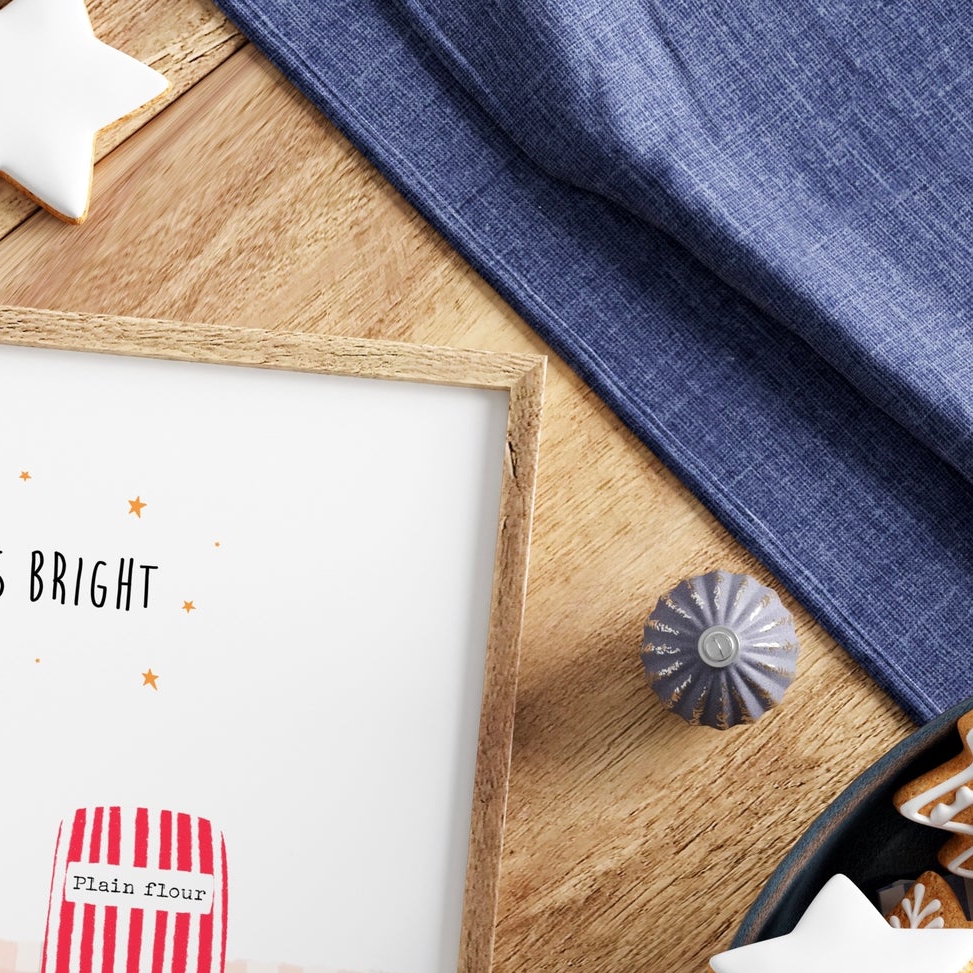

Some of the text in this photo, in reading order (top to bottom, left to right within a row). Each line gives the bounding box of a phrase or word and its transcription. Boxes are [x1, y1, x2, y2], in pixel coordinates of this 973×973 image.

[29, 549, 159, 612] BRIGHT
[73, 875, 207, 901] Plain flour
